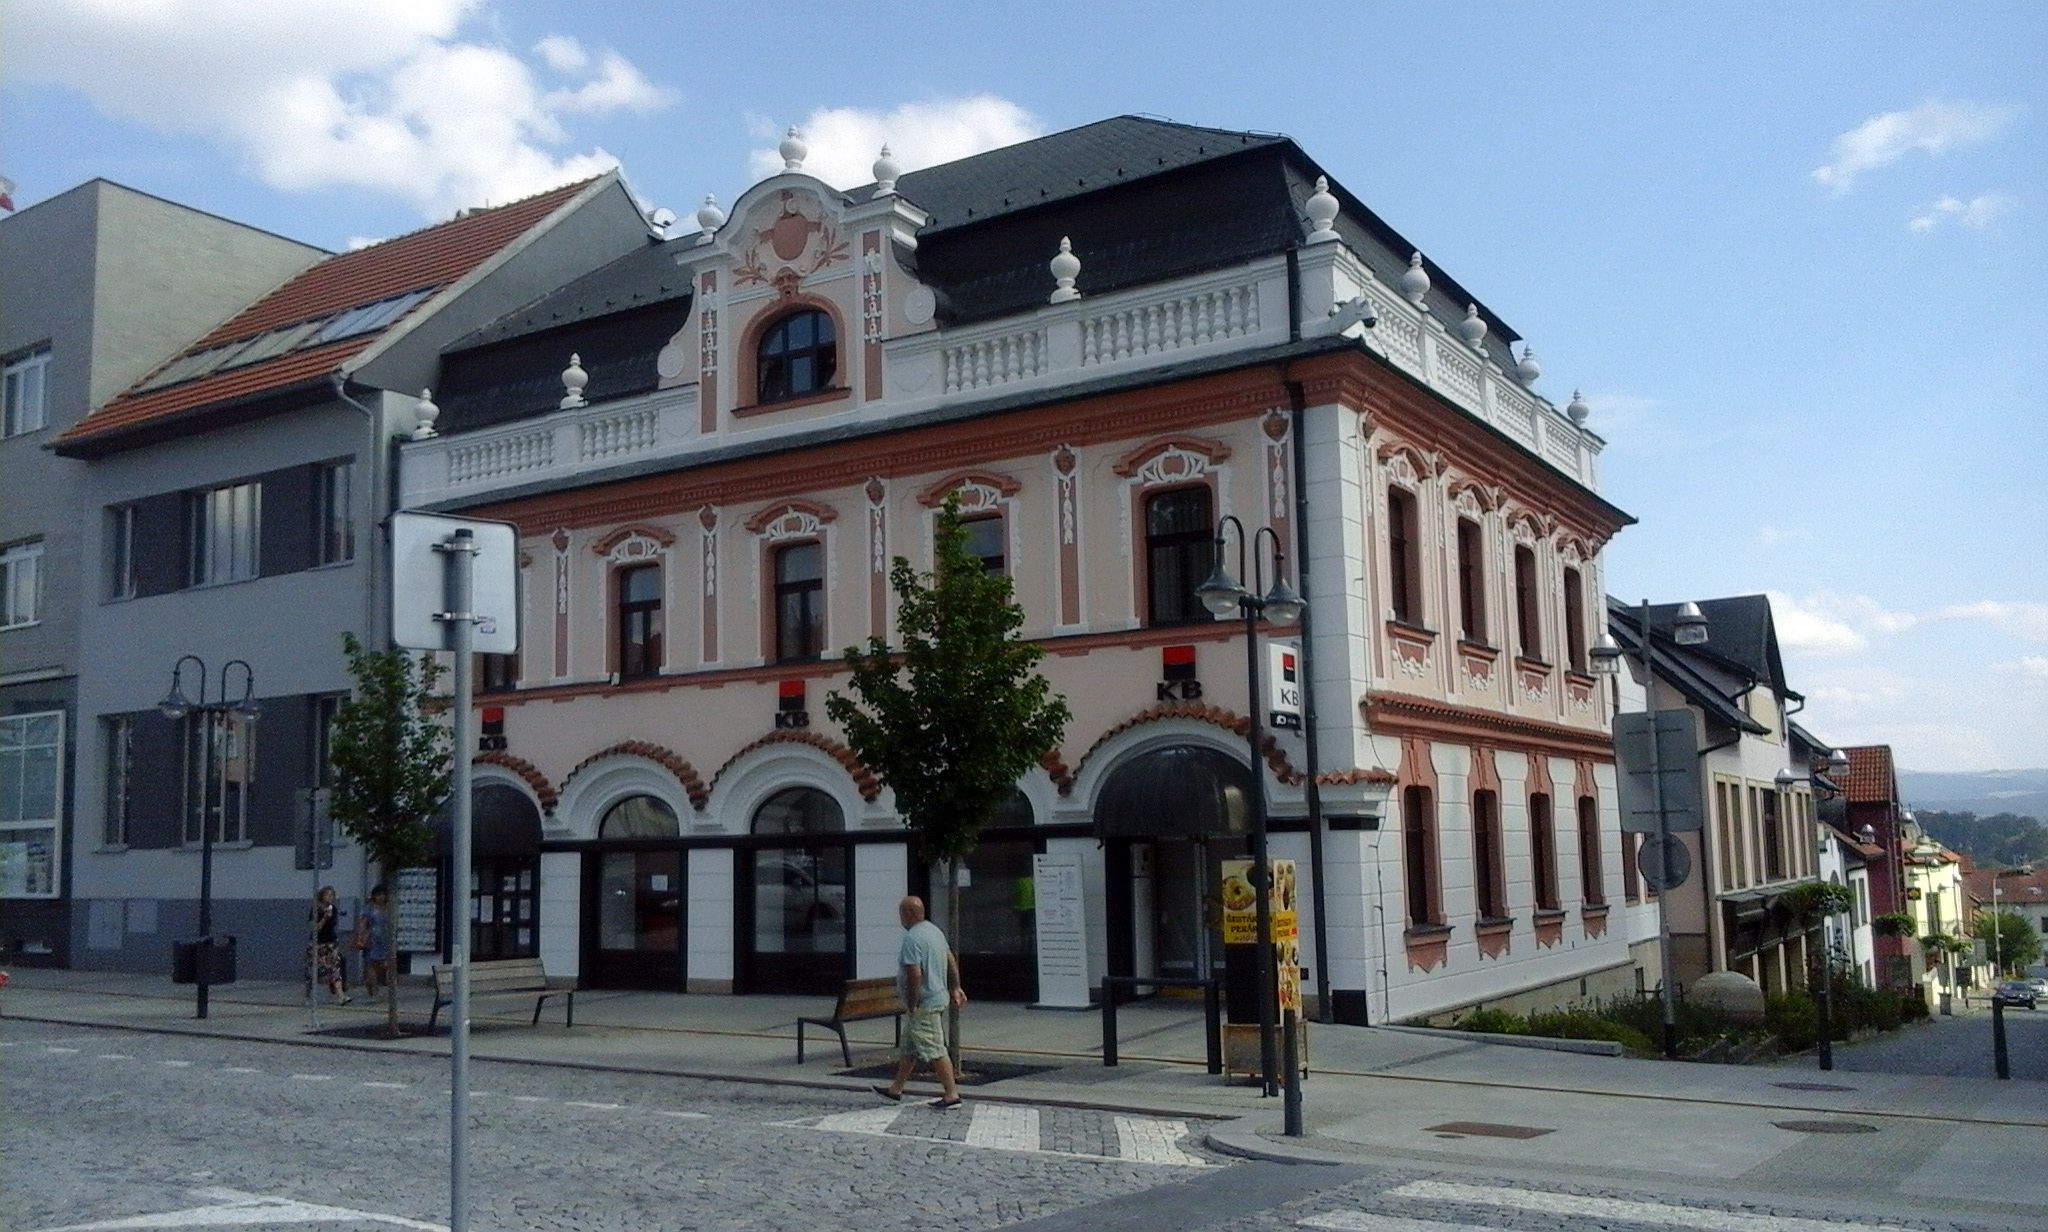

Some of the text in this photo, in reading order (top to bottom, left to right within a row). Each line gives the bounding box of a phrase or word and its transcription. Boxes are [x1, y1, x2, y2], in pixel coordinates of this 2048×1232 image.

[1157, 679, 1203, 701] KB
[1280, 687, 1299, 706] KB
[775, 711, 810, 729] KB
